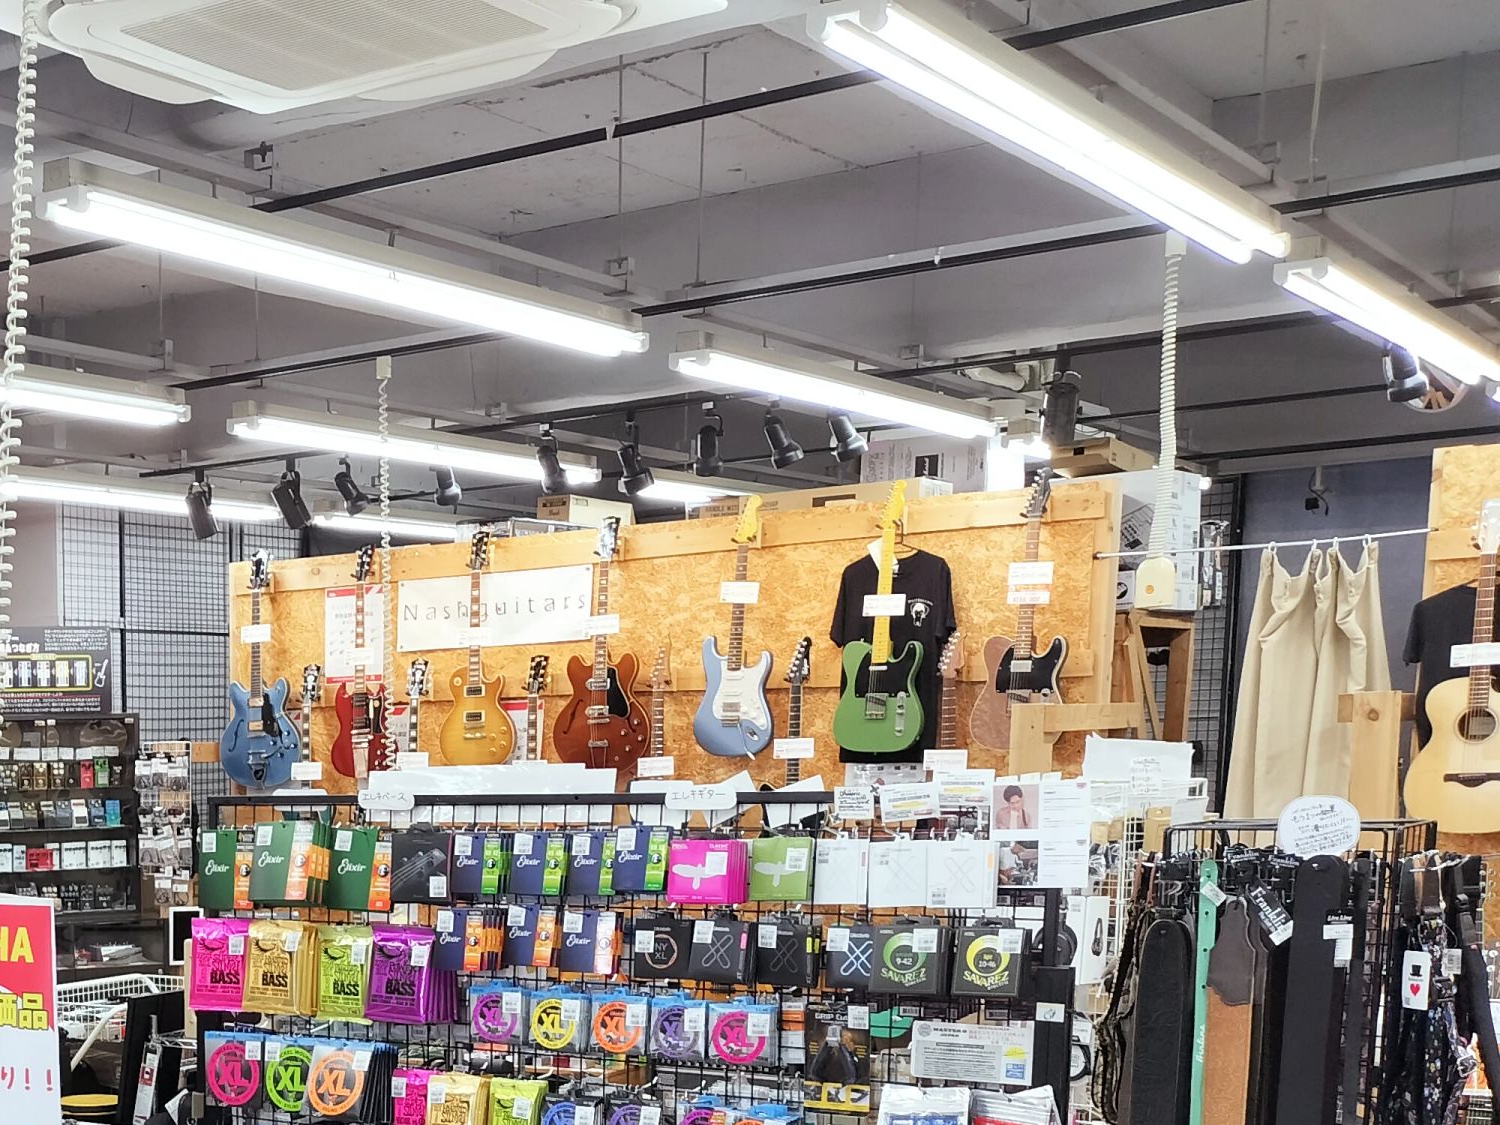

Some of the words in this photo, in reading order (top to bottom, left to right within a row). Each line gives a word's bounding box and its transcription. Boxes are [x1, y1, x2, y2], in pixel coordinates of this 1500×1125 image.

[258, 851, 285, 868] Elixir
[456, 855, 479, 868] Elixir
[516, 855, 541, 868] Elixir
[574, 854, 598, 868] Elixir
[618, 851, 643, 864] Elixir
[205, 859, 230, 876] Elixir
[337, 858, 367, 875] Elixir
[439, 932, 462, 945] Elixir
[508, 926, 533, 939] Elixir
[566, 934, 591, 947] Elixir
[655, 952, 668, 960] XL
[210, 969, 241, 985] BASS
[262, 972, 288, 988] BASS
[880, 967, 927, 983] SAVAREZ
[963, 970, 1009, 987] SAVAREZ
[333, 980, 360, 996] BASS
[385, 979, 416, 997] BASS
[540, 1012, 565, 1034] XL
[605, 1014, 632, 1037] XL
[726, 1027, 755, 1049] XL
[218, 1061, 251, 1086] XL
[276, 1066, 306, 1091] XL
[317, 1069, 351, 1096] XL
